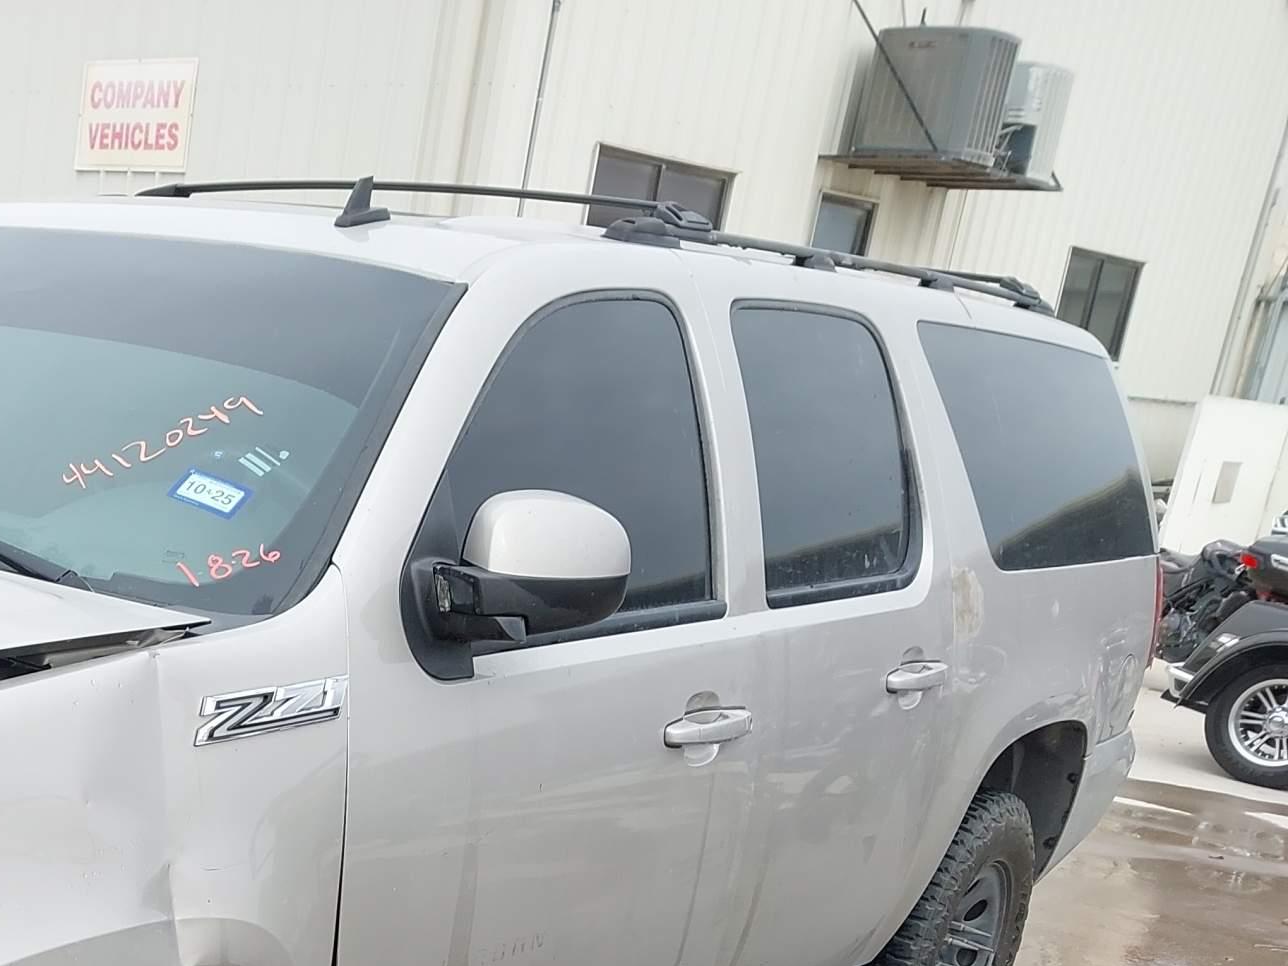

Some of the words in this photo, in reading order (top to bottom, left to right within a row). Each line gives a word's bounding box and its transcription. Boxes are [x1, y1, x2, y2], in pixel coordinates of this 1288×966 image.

[90, 79, 186, 110] COMPANY
[88, 121, 180, 151] VEHICLES
[62, 396, 264, 489] 44120249
